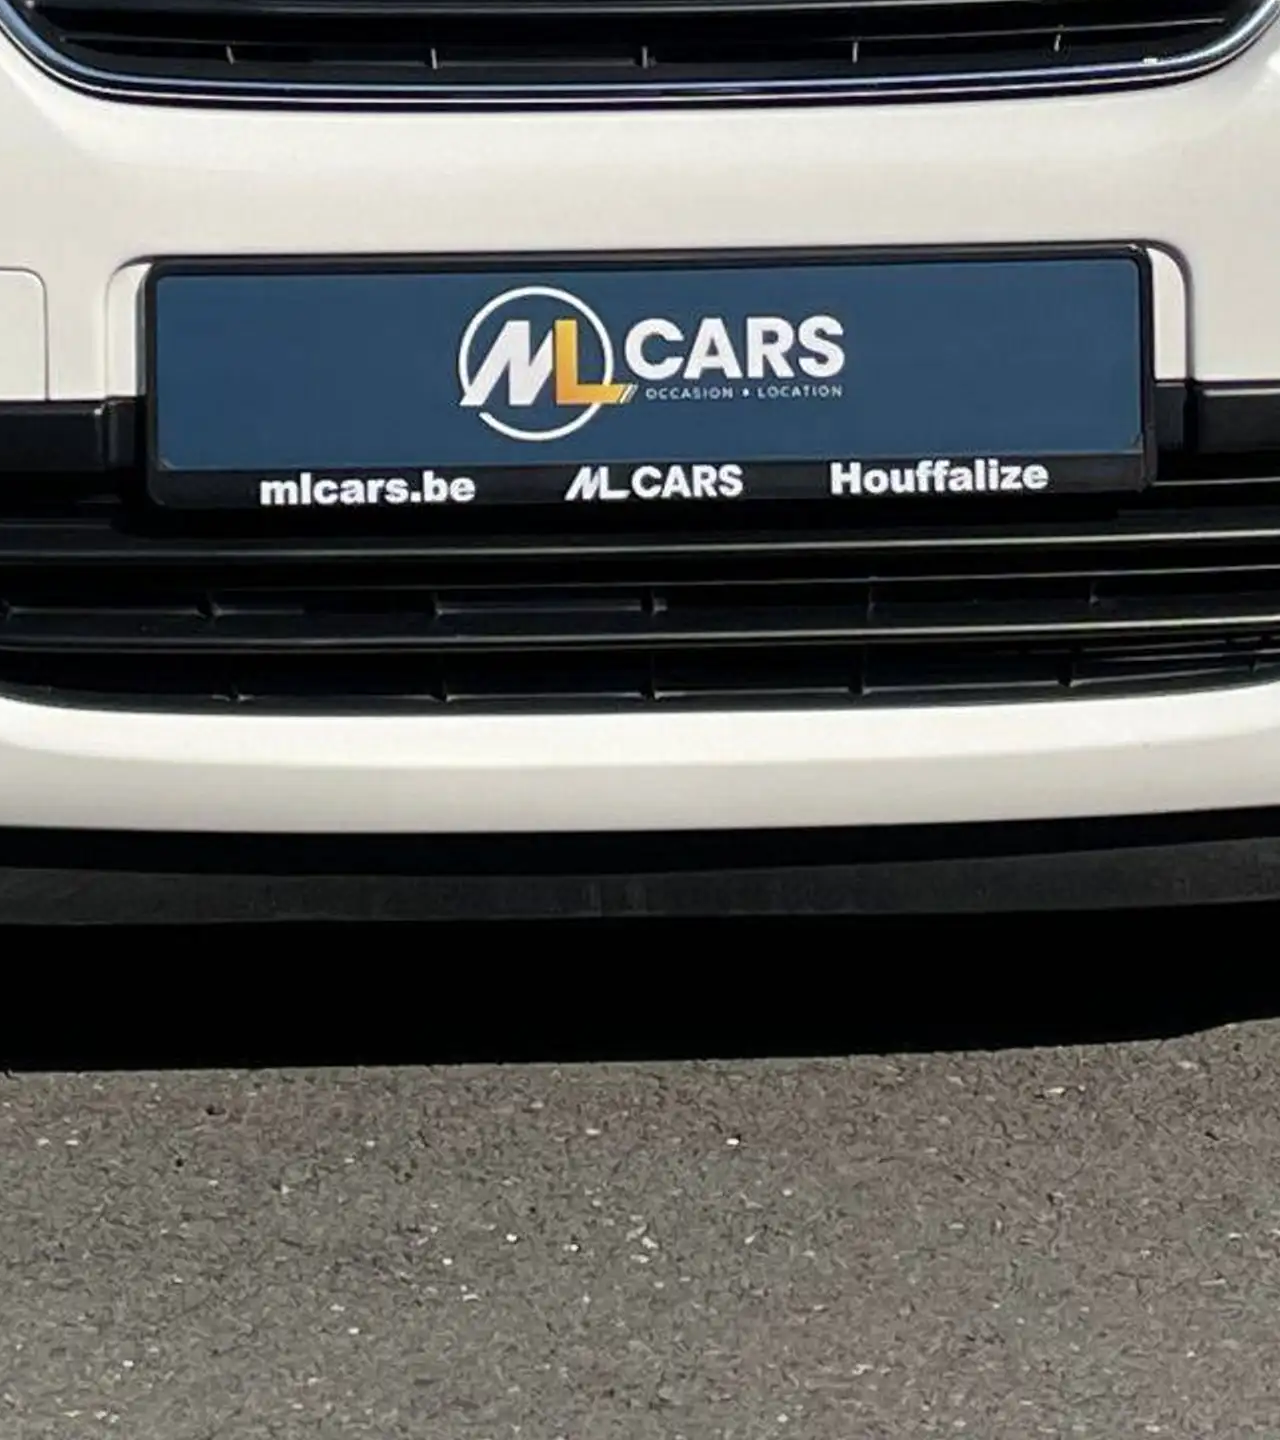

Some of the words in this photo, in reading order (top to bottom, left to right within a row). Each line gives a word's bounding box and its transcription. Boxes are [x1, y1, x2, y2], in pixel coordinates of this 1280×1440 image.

[623, 314, 846, 381] CARS
[644, 383, 734, 401] OCCASION
[756, 383, 844, 399] LOCATION
[259, 471, 477, 507] mlcars.be
[830, 460, 1049, 495] Houffalize
